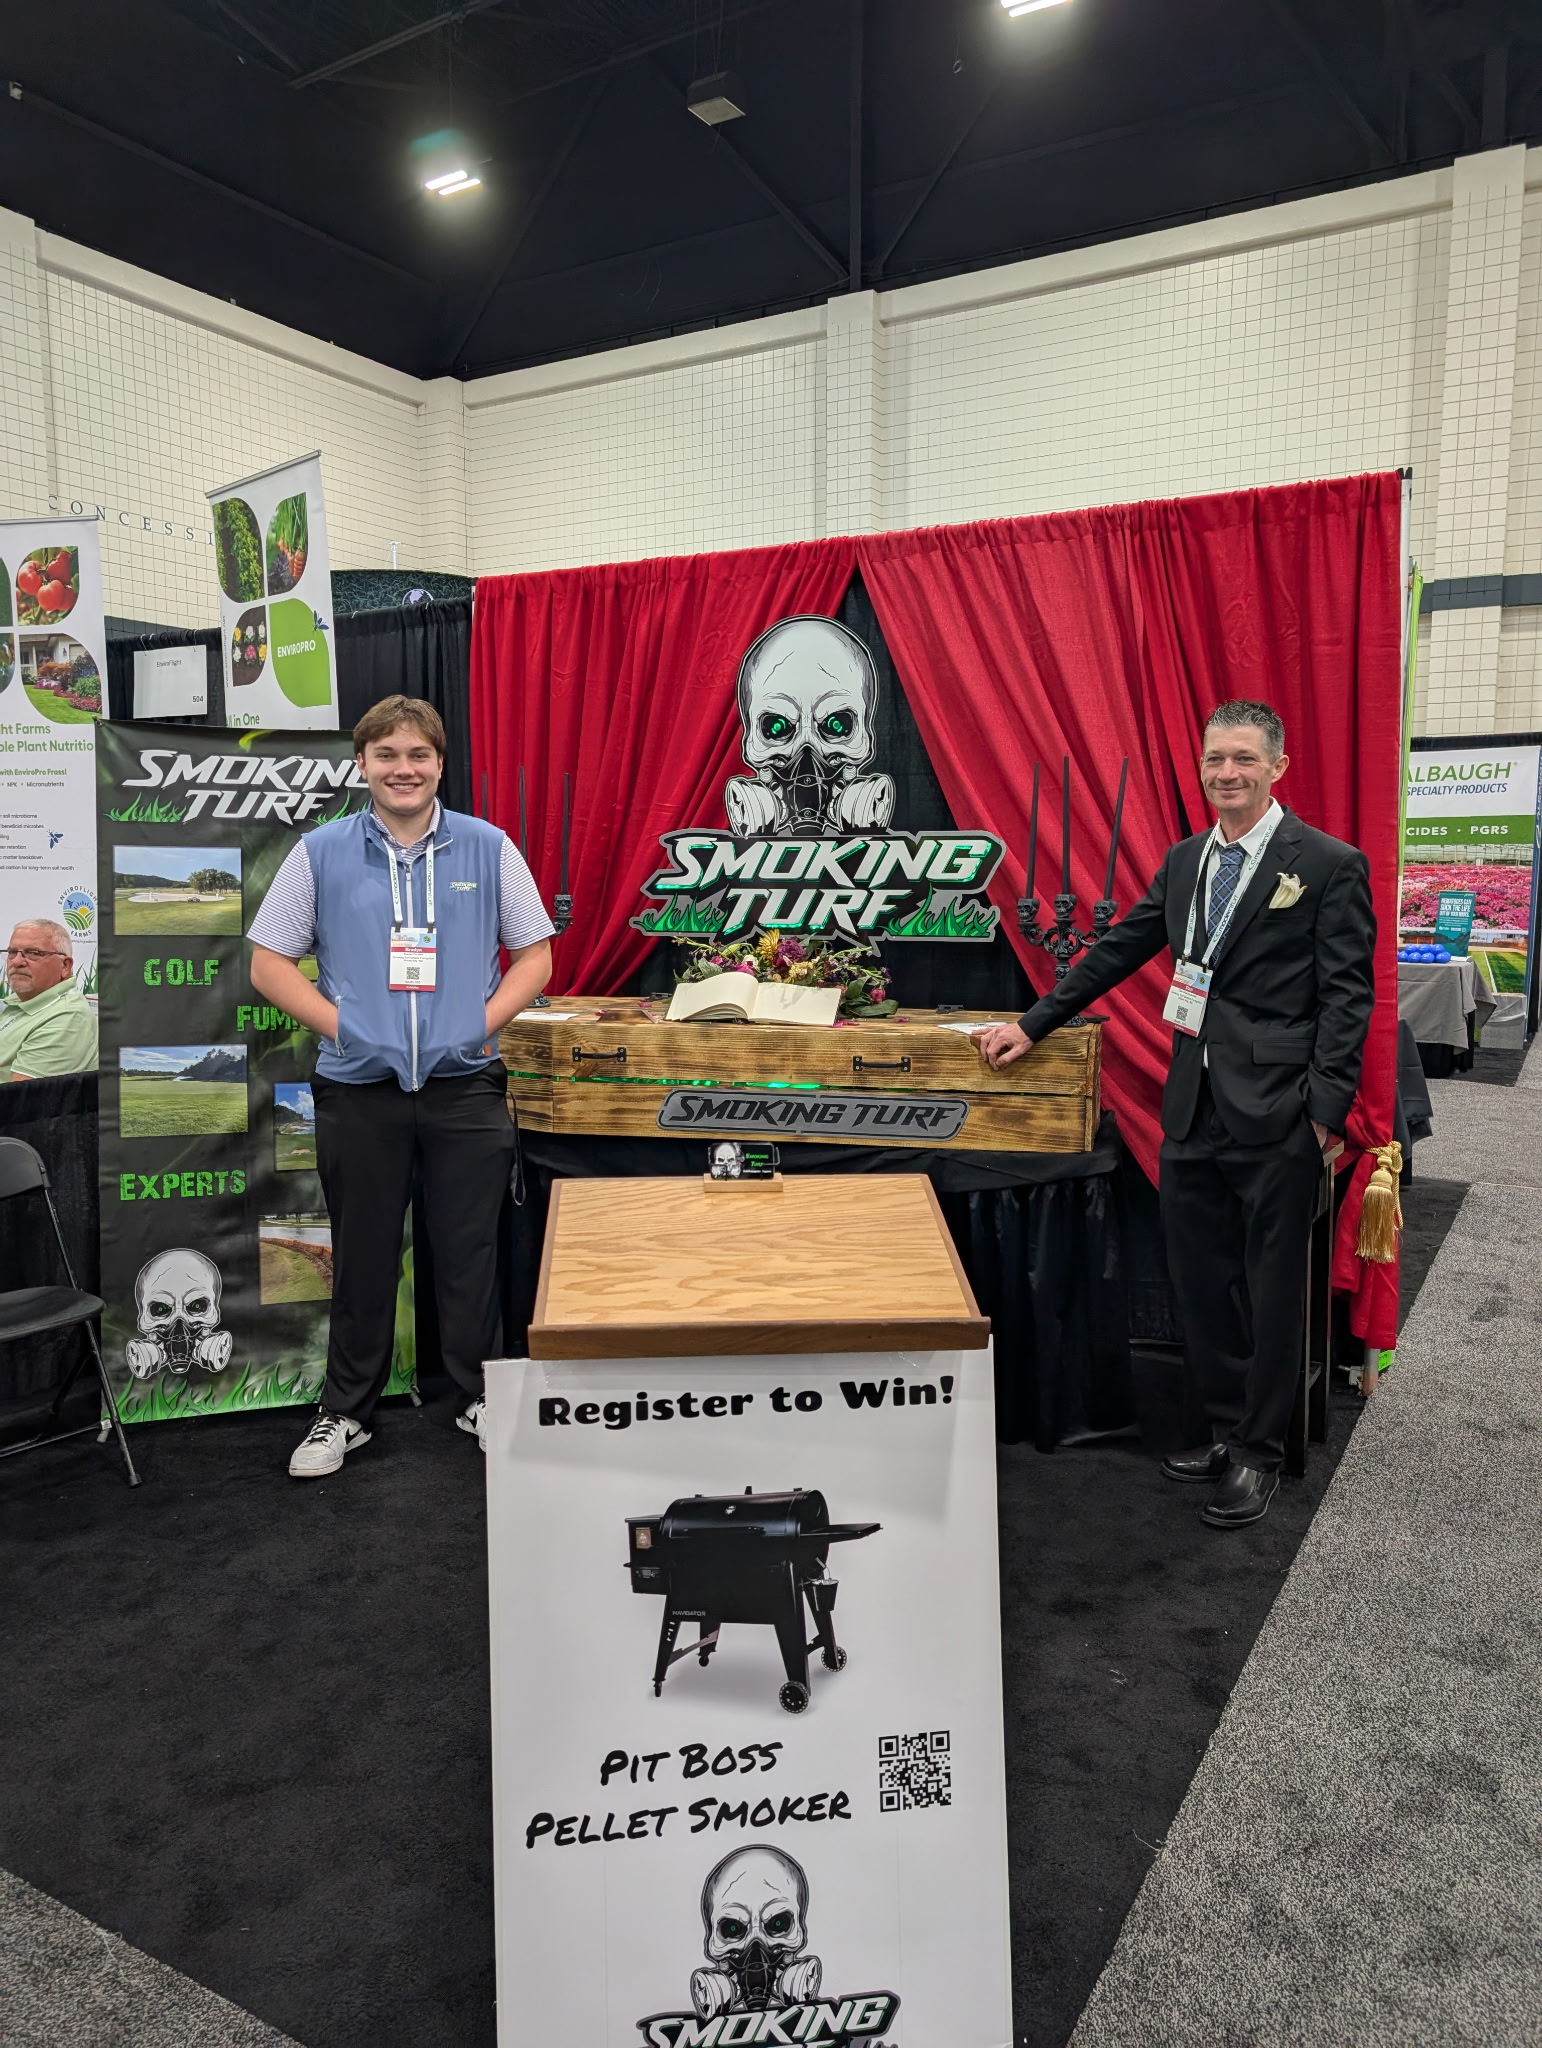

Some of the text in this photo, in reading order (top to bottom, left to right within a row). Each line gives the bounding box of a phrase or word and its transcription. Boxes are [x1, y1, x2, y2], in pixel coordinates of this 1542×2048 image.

[48, 494, 214, 545] CONCESSI
[277, 639, 316, 657] ENVIROPRO
[192, 695, 204, 703] 504
[1, 723, 51, 735] ht Farms
[234, 714, 241, 727] in
[243, 712, 260, 726] One
[17, 740, 48, 752] Plant
[49, 739, 94, 752] Nutritio
[14, 768, 47, 776] EnviroPro
[1455, 782, 1508, 795] PRODUCTS
[182, 789, 336, 825] TURF
[1406, 825, 1509, 836] CIDES PGRS
[655, 837, 993, 891] SMOKING
[57, 885, 98, 905] ENVIROFLIGH
[722, 888, 915, 937] TURF
[71, 929, 92, 938] FARMS
[143, 957, 220, 986] GOLF
[236, 1005, 302, 1032] FUM
[669, 1095, 960, 1132] SMOKING TURF
[119, 1169, 247, 1201] EXPERTS
[538, 1375, 955, 1431] Register to Win!
[600, 1741, 784, 1786] PIT BOSS
[526, 1790, 852, 1849] PELLET SMOKER
